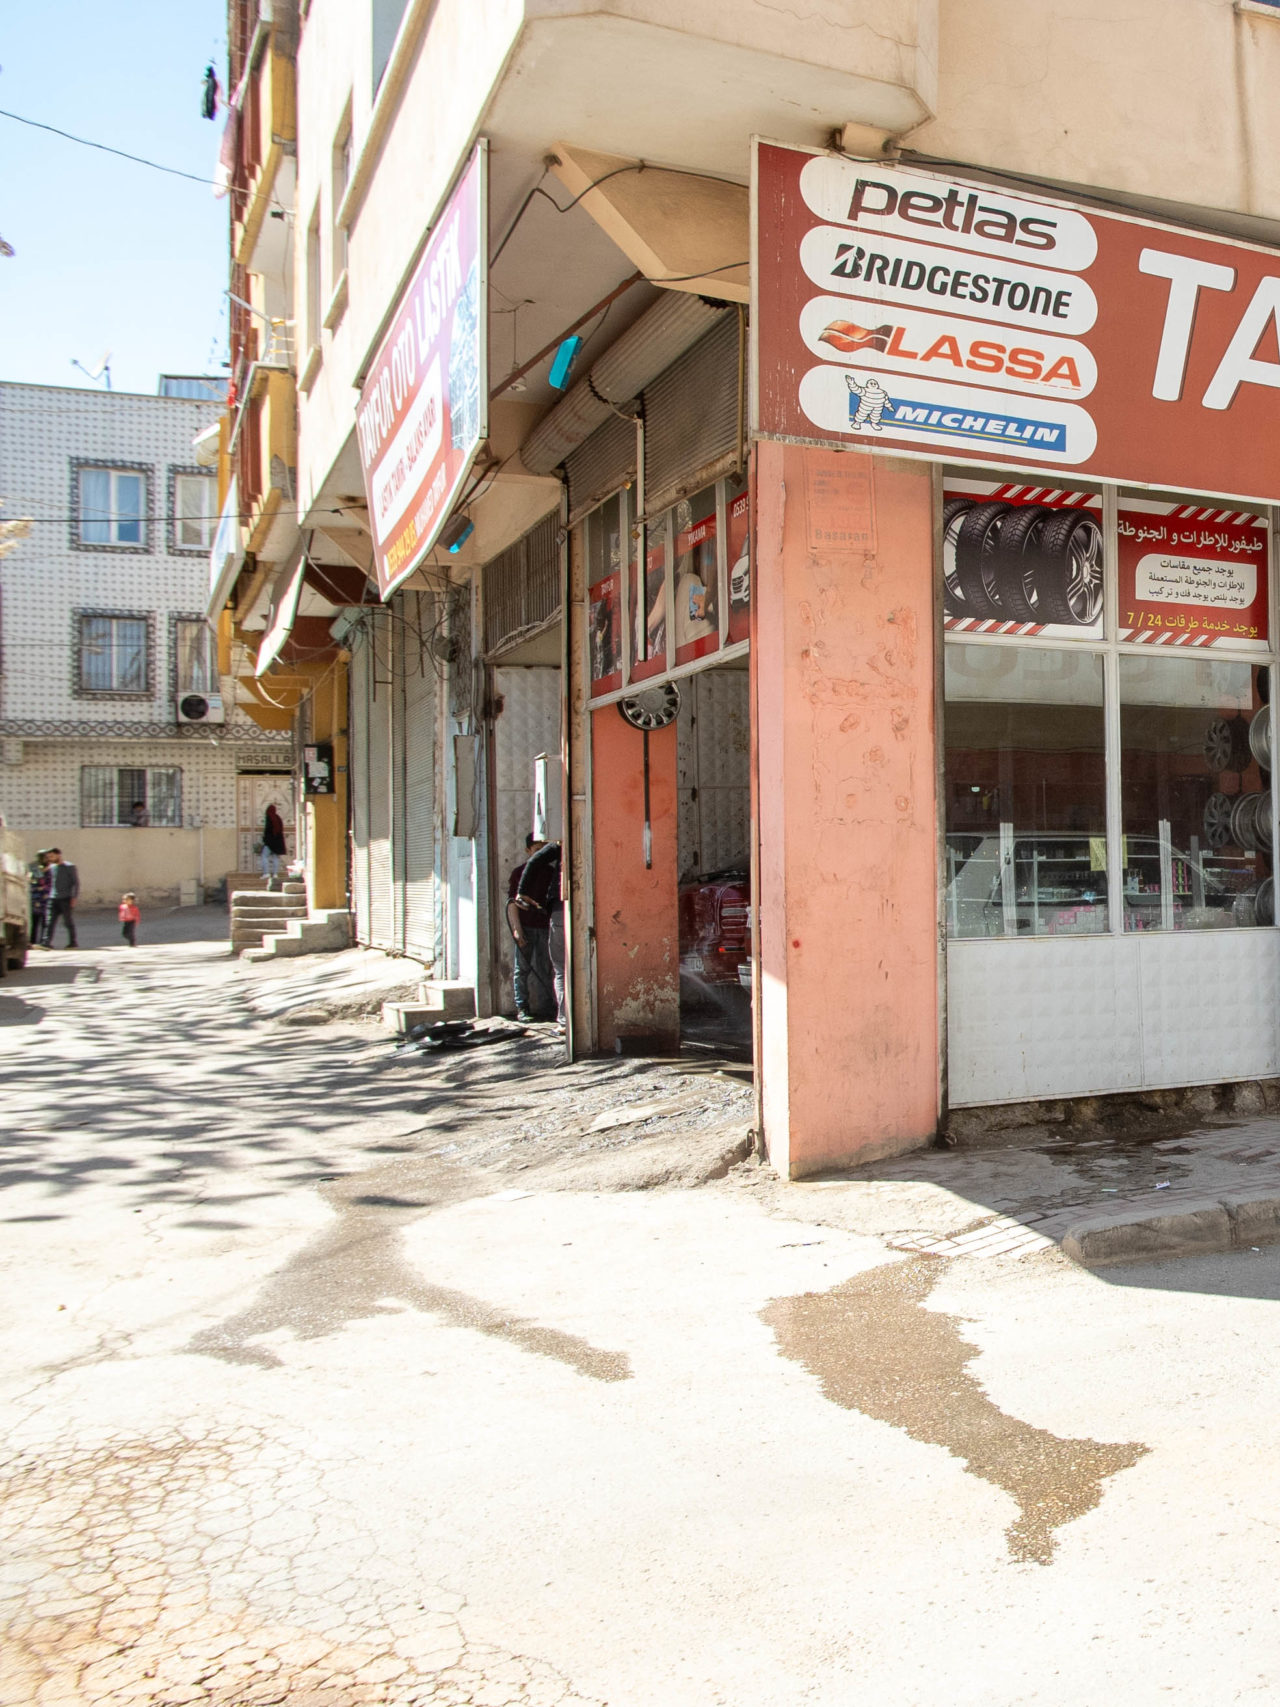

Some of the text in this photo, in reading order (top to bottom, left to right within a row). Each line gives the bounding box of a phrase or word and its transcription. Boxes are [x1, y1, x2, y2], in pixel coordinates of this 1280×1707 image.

[847, 178, 1058, 251] petlas
[830, 243, 1072, 318] BRIDGESTONE
[886, 326, 1082, 387] LASSA
[359, 366, 395, 469] TAYFUR
[391, 317, 416, 411] OTO
[894, 406, 1061, 443] MICHELIN
[1117, 520, 1167, 542] الجنوطة
[1170, 532, 1178, 544] و
[1229, 535, 1264, 553] طيفور
[1160, 560, 1234, 578] يوجد جميع مقاسات
[1147, 613, 1162, 627] 24
[1165, 614, 1199, 632] طرقات
[1202, 617, 1230, 630] خدمة
[1233, 623, 1258, 638] يوجد
